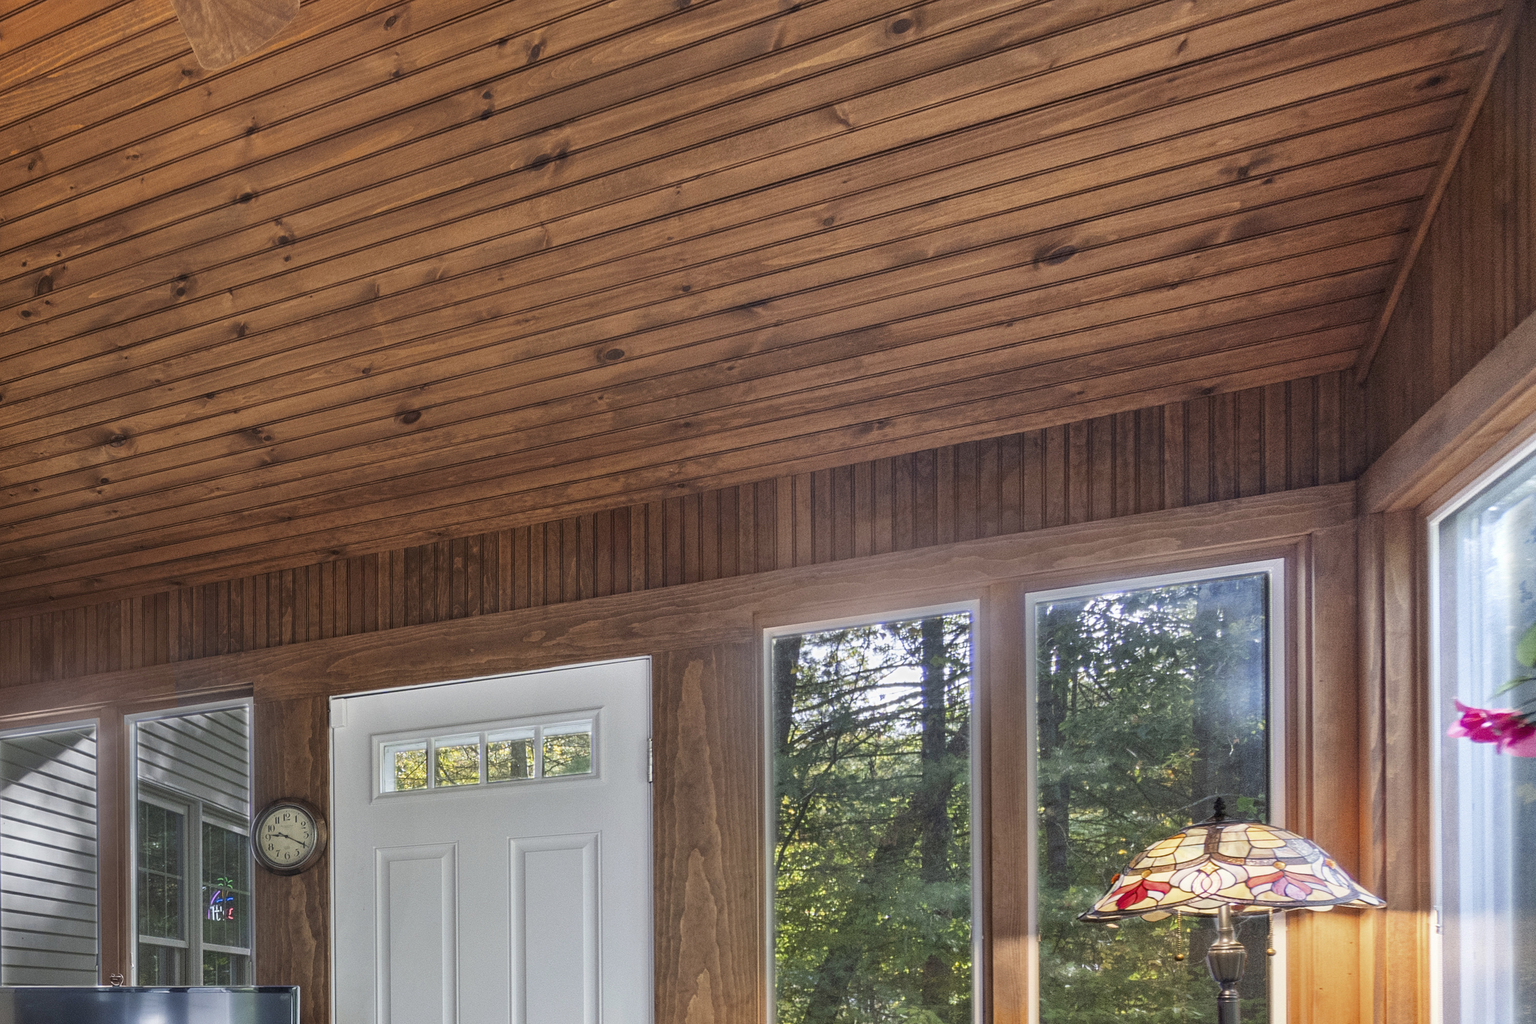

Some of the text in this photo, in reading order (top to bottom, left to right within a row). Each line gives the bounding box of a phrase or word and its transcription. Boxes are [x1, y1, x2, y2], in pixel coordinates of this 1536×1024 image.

[283, 812, 291, 821] 12
[300, 821, 306, 829] 2
[268, 843, 274, 851] 8
[276, 849, 280, 857] 7
[284, 851, 291, 860] 6
